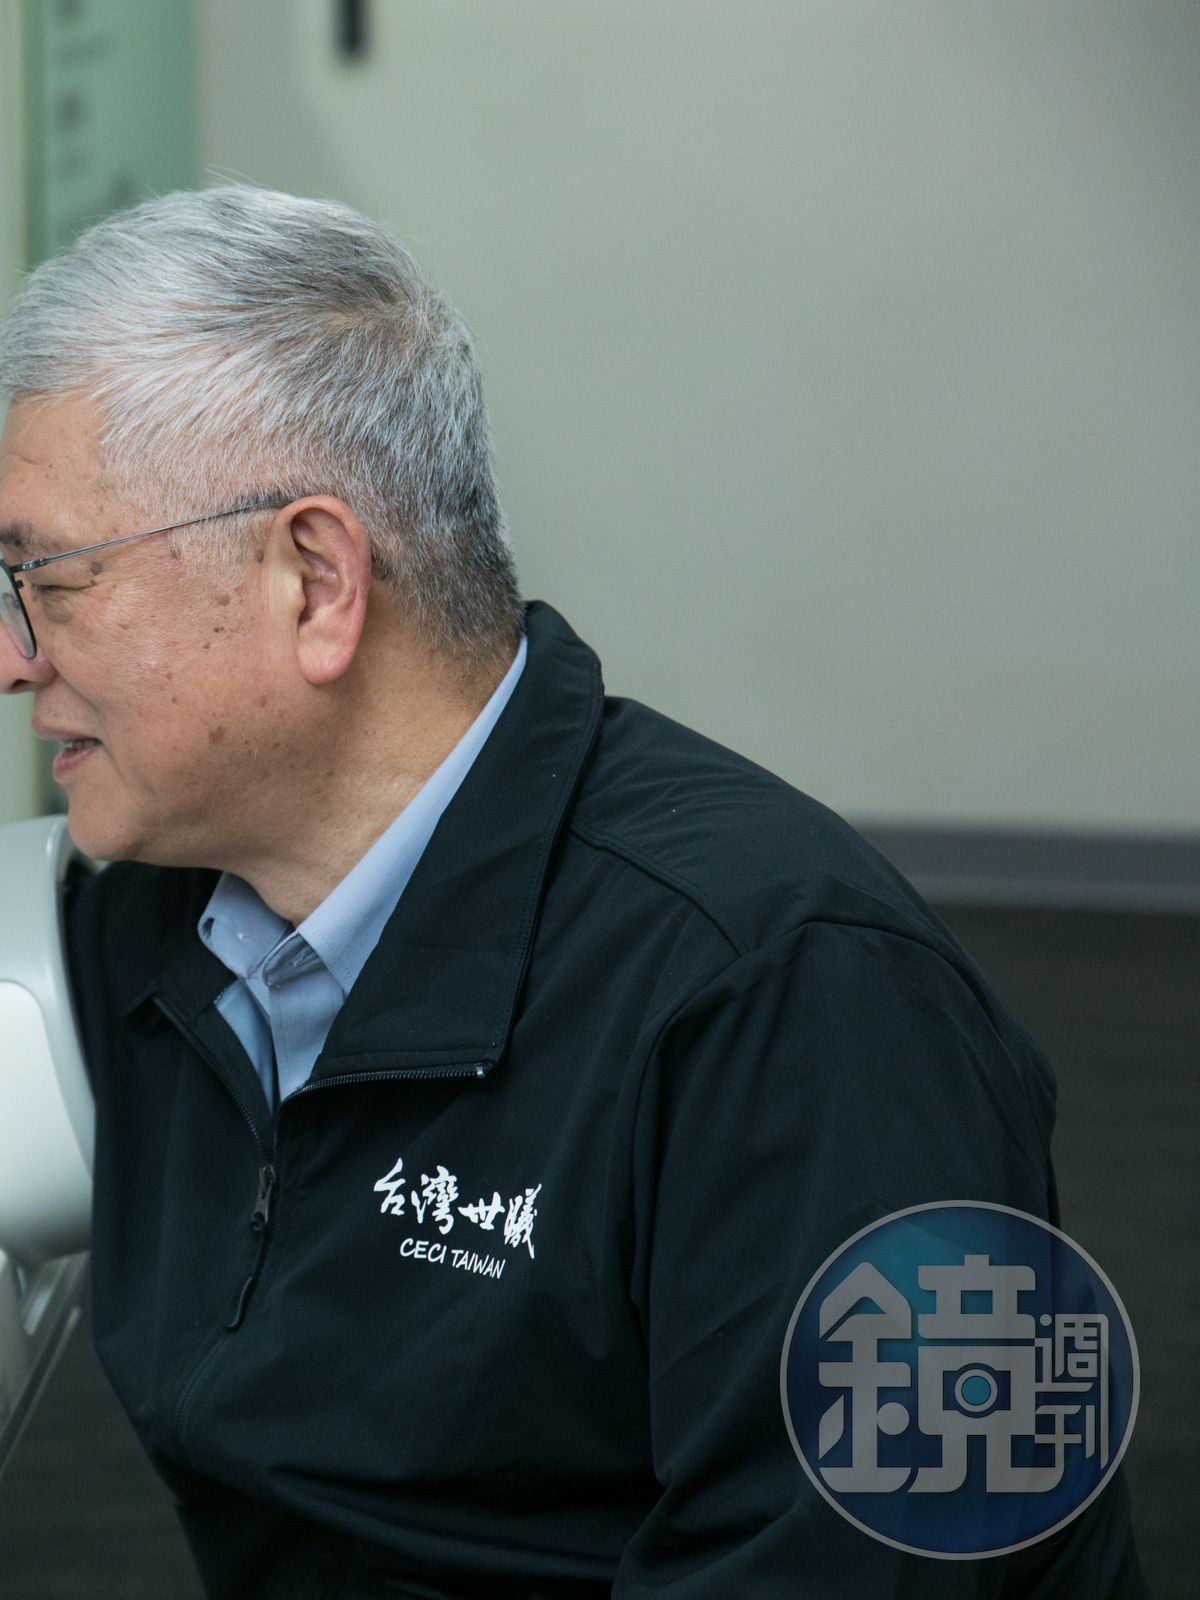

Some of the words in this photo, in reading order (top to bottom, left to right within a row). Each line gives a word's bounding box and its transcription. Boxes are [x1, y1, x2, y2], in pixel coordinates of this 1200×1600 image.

[373, 1157, 542, 1259] 台灣世曦
[400, 1238, 447, 1264] CECI
[450, 1249, 506, 1280] TAIWAN
